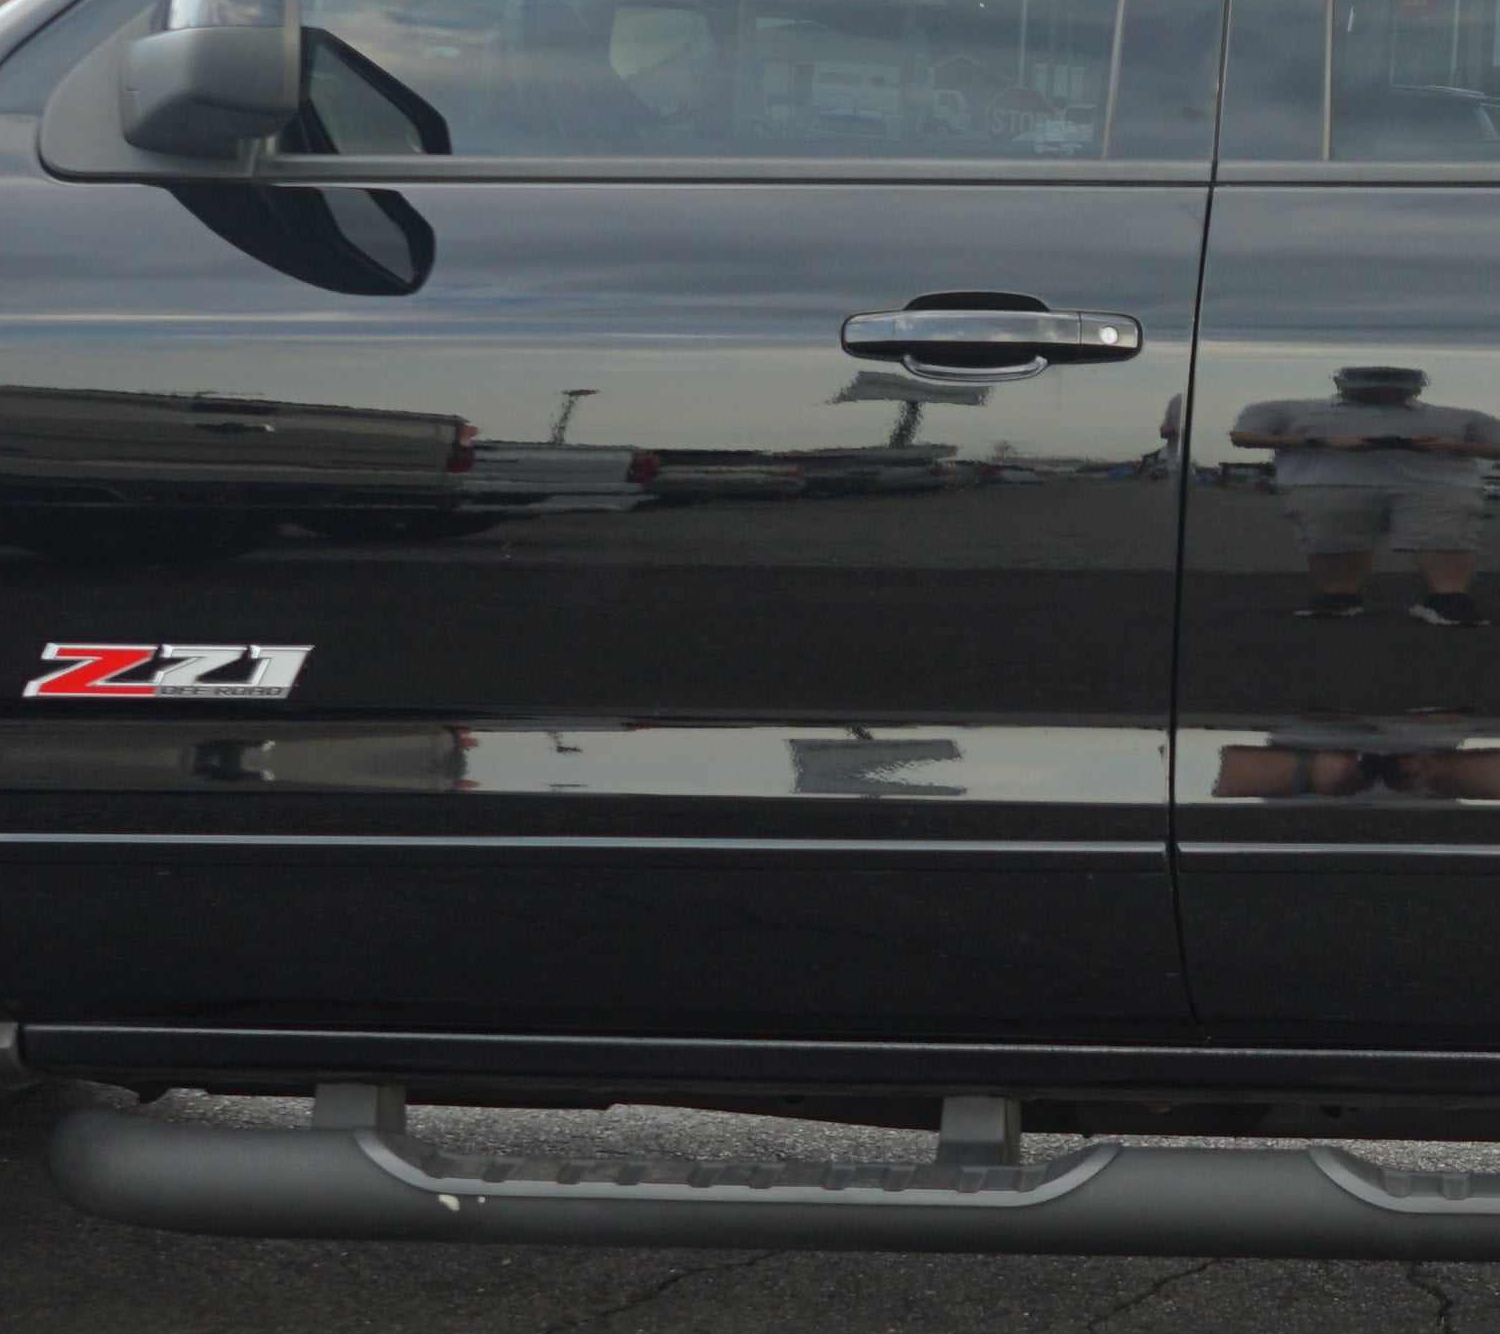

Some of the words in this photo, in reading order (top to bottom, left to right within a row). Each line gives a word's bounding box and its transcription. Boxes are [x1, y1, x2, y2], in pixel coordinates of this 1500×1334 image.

[22, 642, 315, 699] Z71
[159, 687, 209, 696] OFF
[214, 687, 284, 697] ROAD
